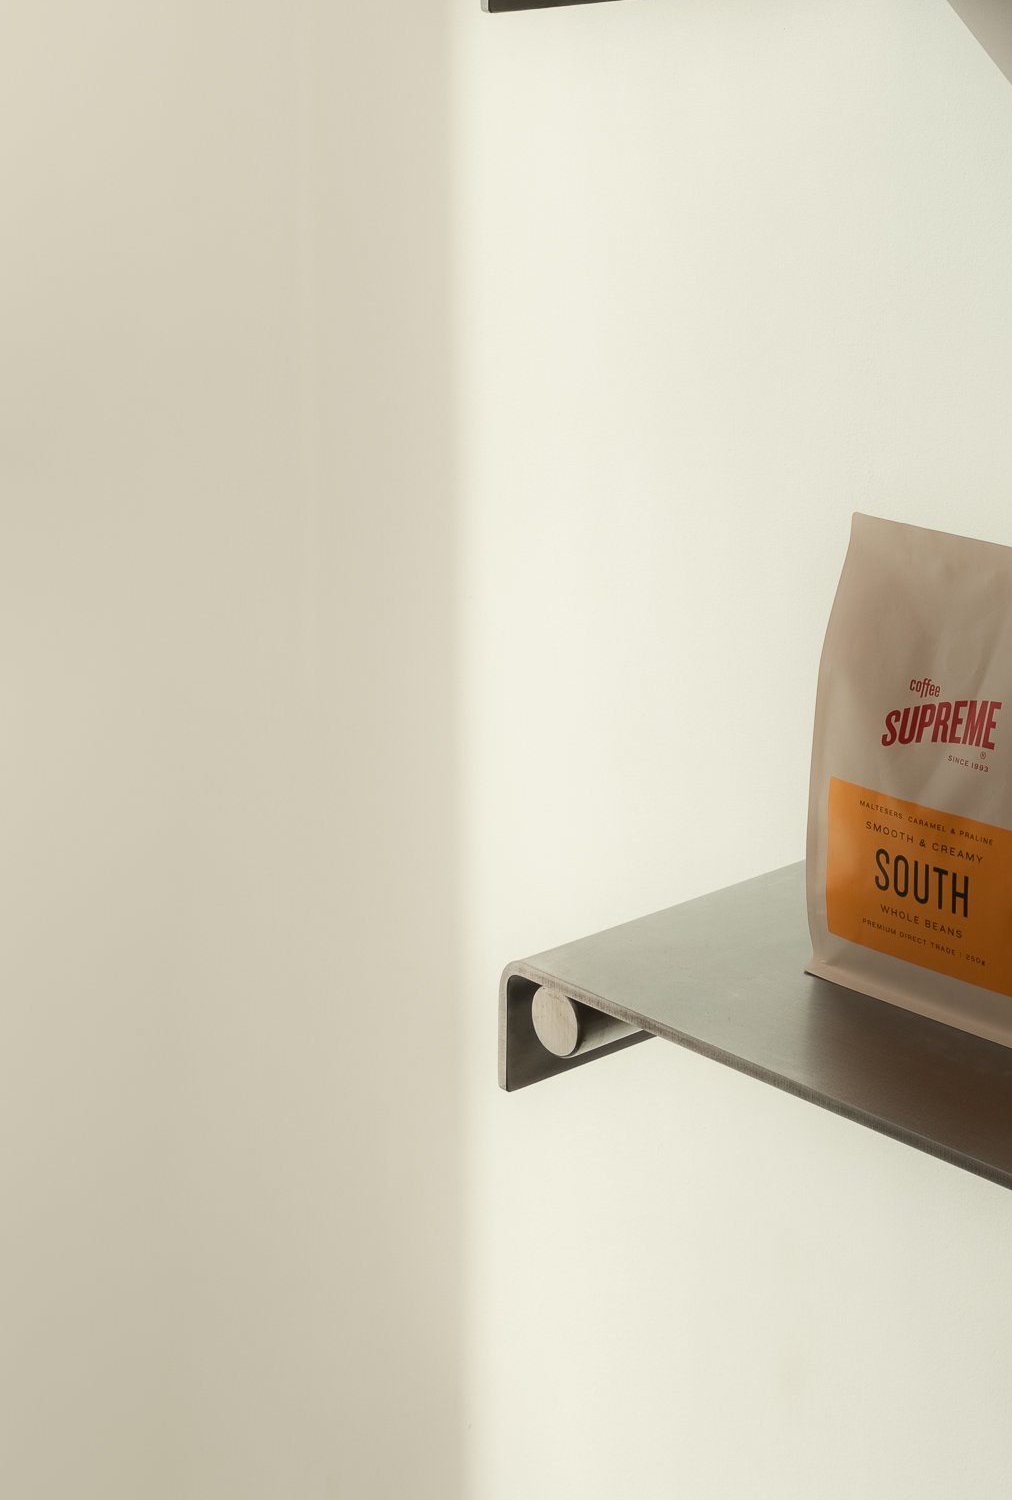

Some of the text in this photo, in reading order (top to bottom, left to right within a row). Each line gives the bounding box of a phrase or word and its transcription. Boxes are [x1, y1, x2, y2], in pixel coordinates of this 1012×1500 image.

[909, 678, 941, 698] coffee
[881, 700, 1002, 750] SUPREME
[948, 755, 989, 772] SINCE 1993
[865, 821, 984, 864] SMOOTH & CREAMY
[908, 816, 947, 833] CARAMEL
[959, 829, 994, 846] PRALINE
[875, 848, 969, 918] SOUTH
[862, 918, 897, 935] PREMIUM
[900, 931, 927, 946] DIRECT
[931, 942, 956, 956] TRADE
[880, 904, 963, 939] WHOLE BEANS
